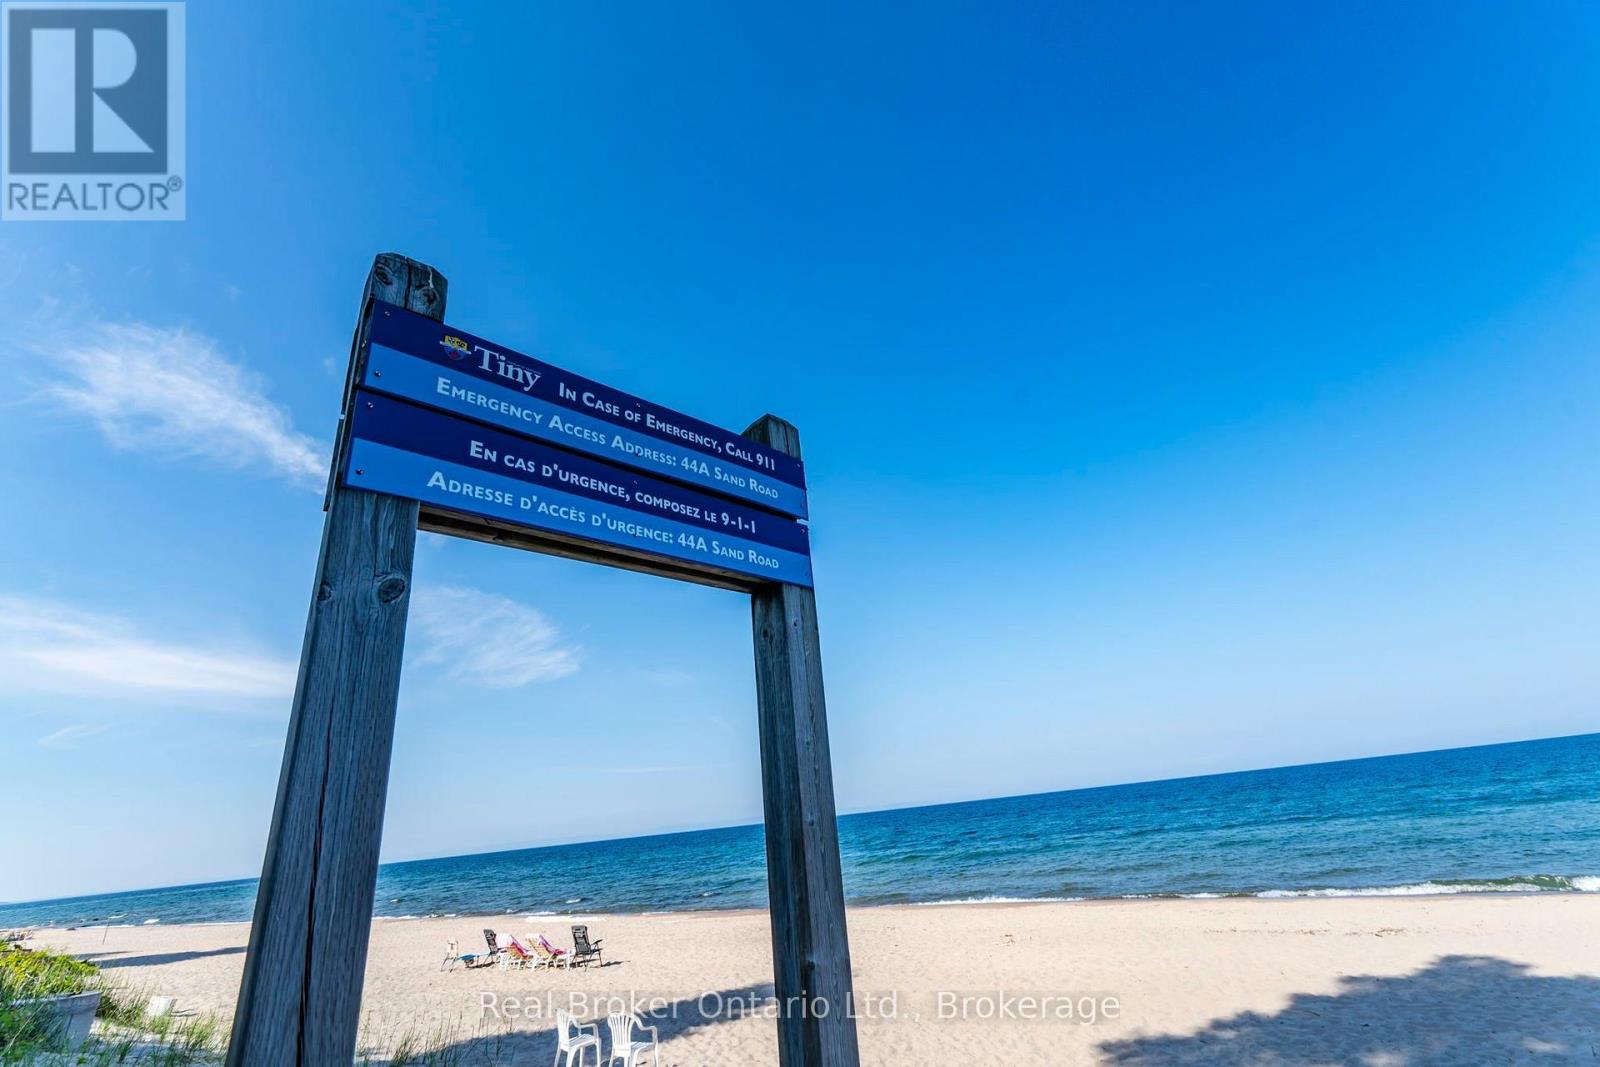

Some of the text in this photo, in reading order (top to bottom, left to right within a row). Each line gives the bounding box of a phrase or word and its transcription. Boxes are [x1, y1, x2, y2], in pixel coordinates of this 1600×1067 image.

[474, 345, 541, 392] Tiny
[681, 456, 710, 477] 44A
[756, 453, 775, 471] 911
[721, 512, 756, 534] 9-1-1
[678, 532, 707, 552] 44A
